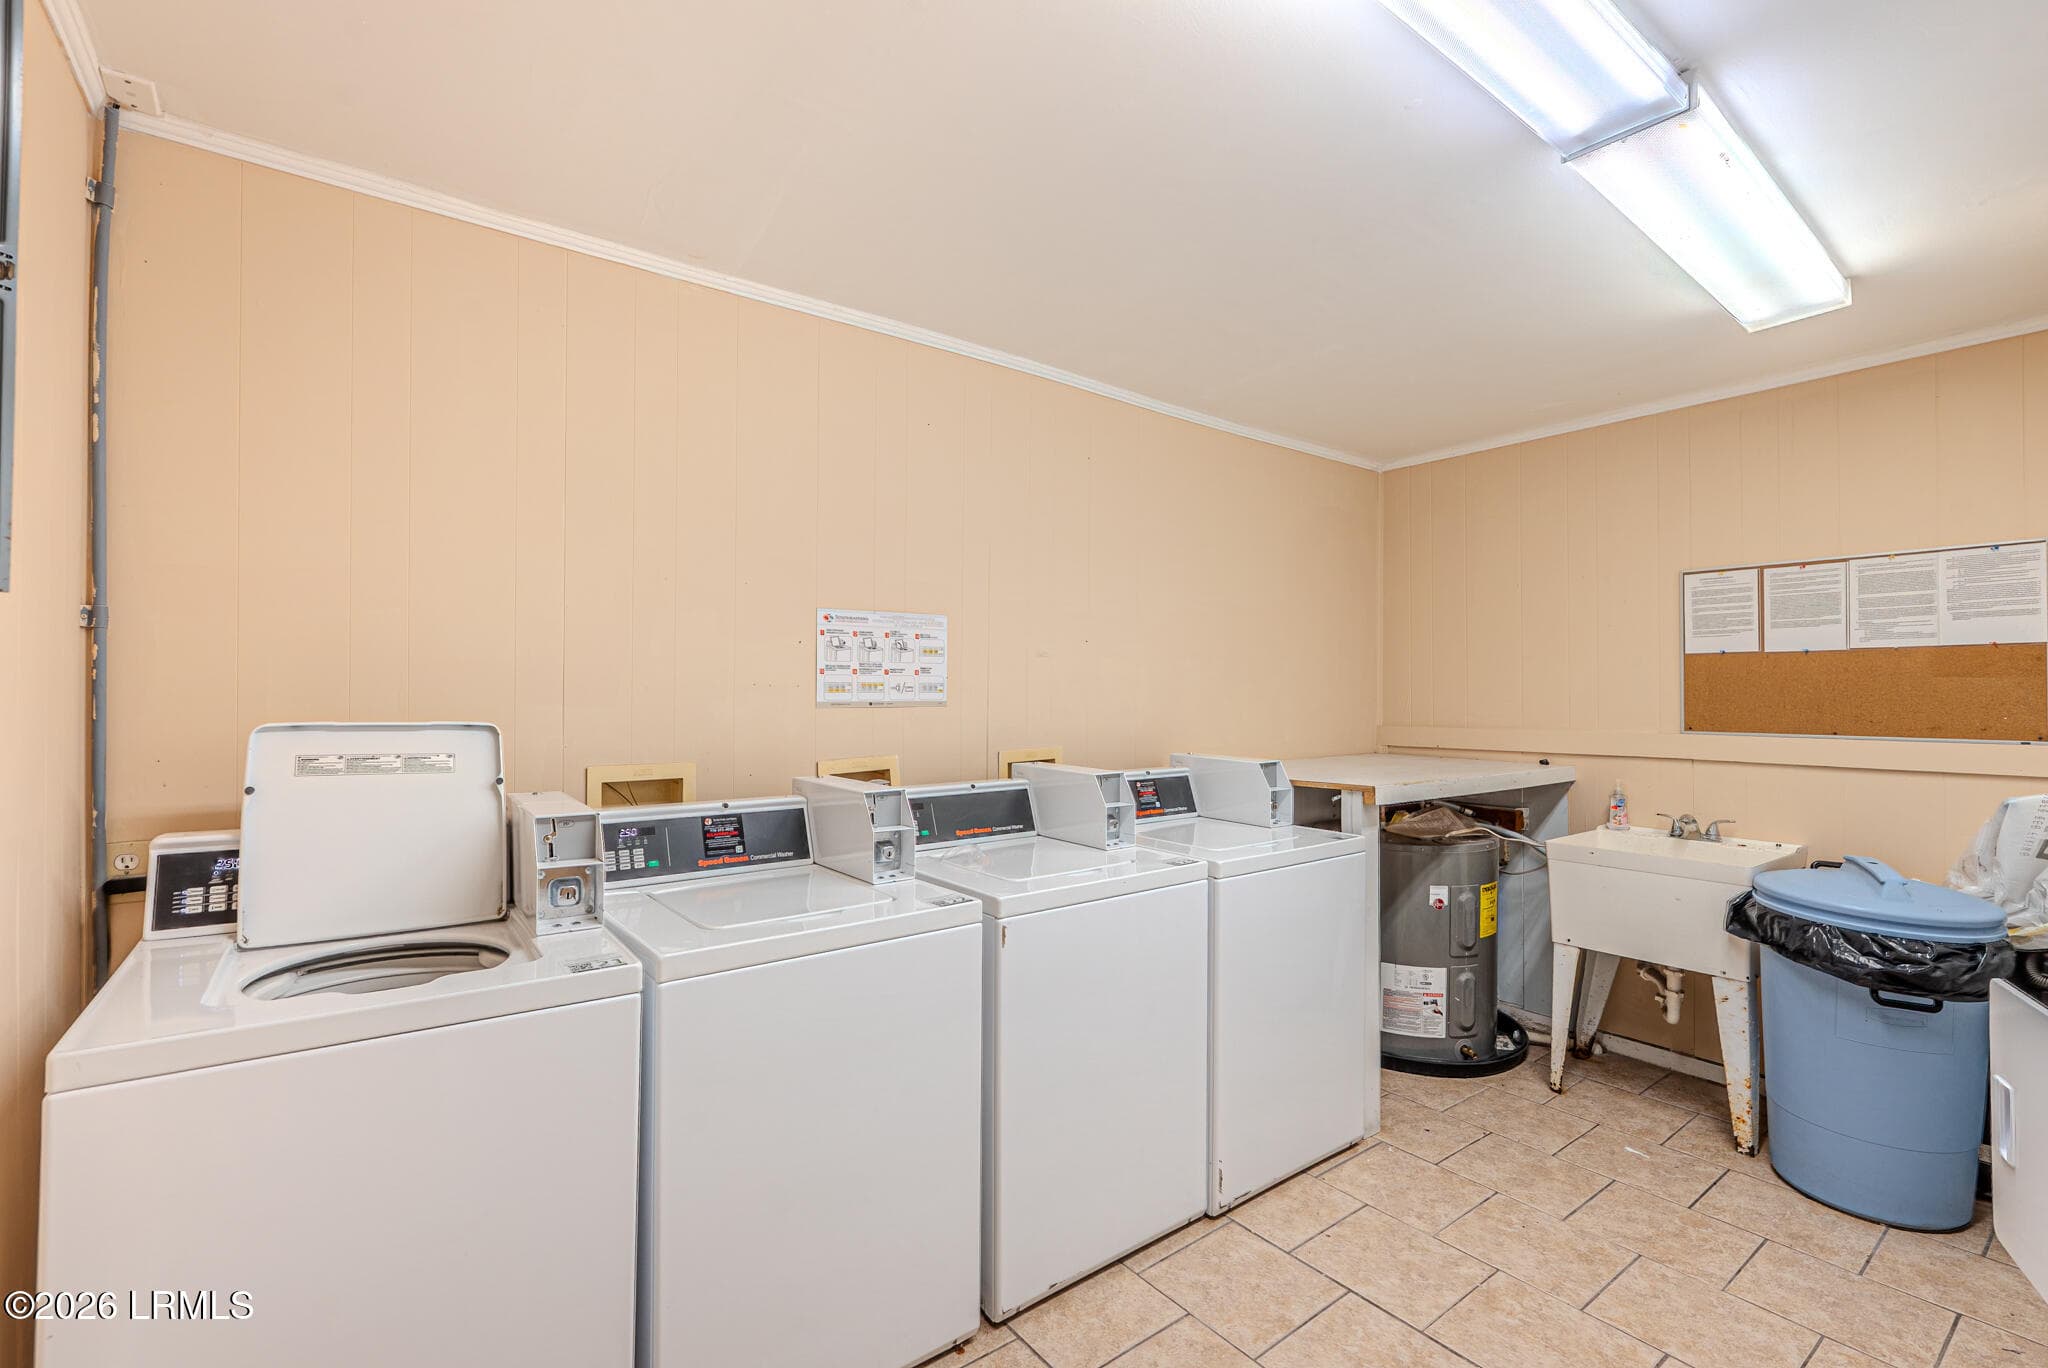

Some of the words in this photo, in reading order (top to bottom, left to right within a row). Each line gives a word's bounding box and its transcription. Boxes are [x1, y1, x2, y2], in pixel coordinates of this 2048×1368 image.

[697, 857, 723, 868] Speed
[723, 854, 750, 864] Queen
[750, 852, 777, 861] Commercial
